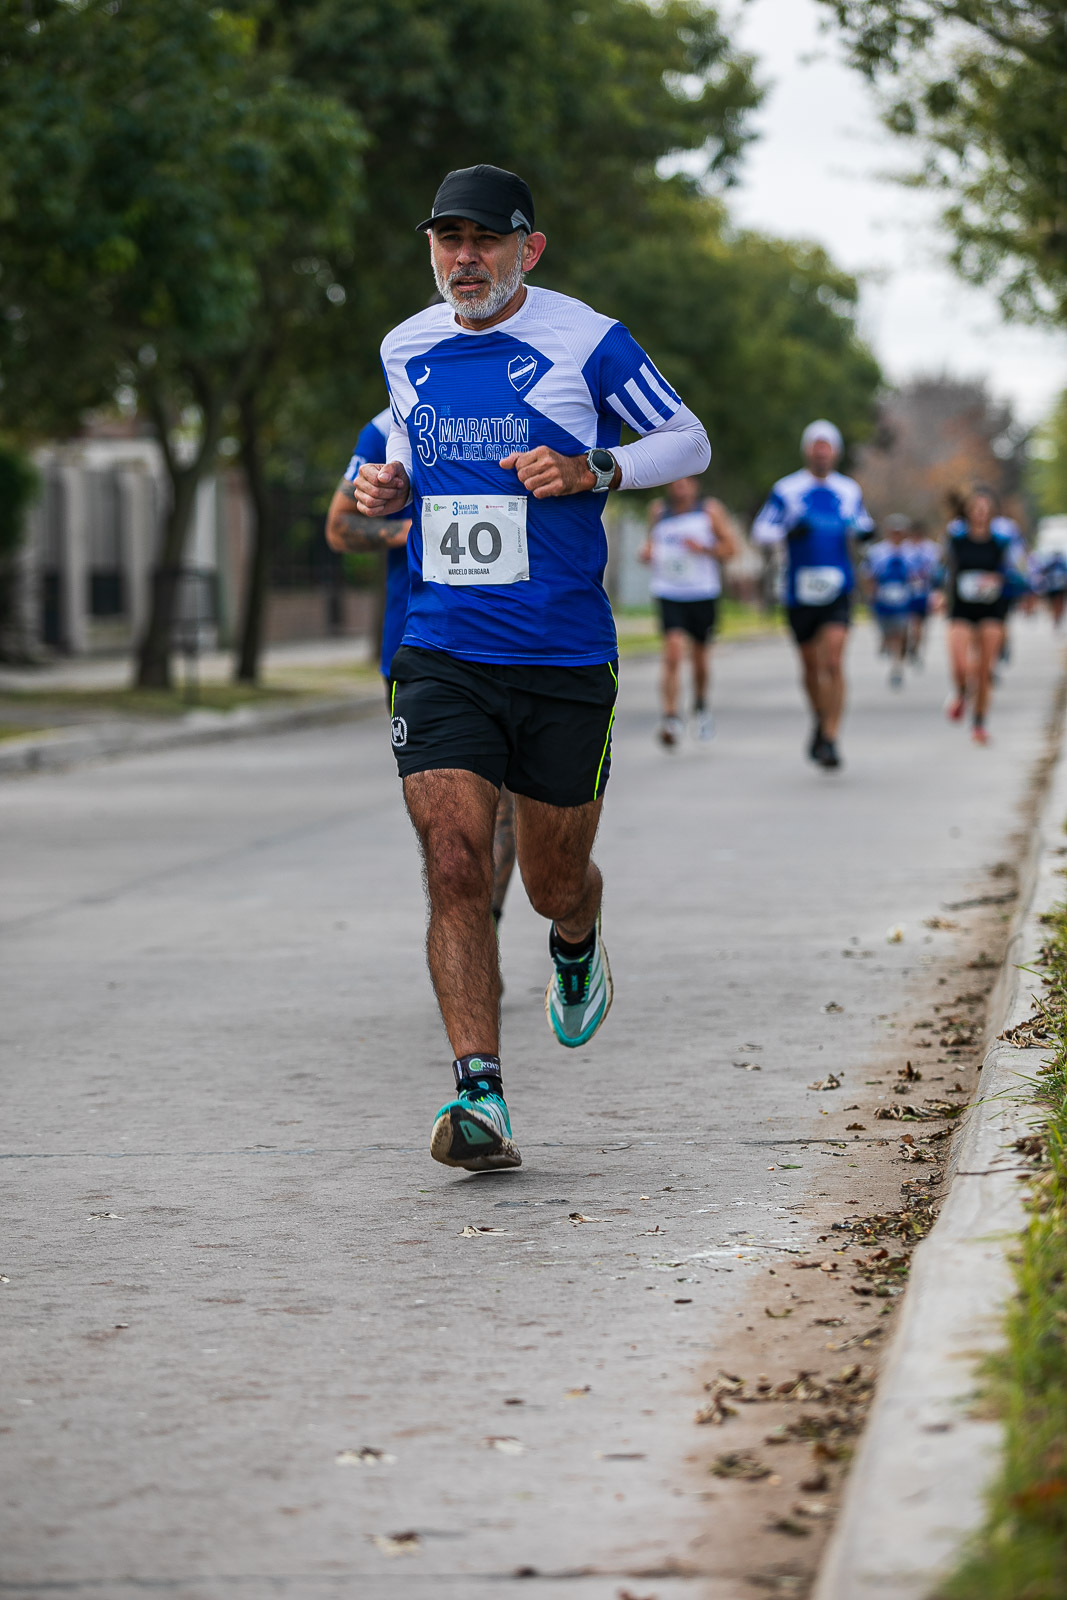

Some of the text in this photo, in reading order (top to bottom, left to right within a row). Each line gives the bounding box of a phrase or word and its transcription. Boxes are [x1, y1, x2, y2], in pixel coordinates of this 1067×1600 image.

[414, 404, 529, 466] 3 MARATÓN
[452, 501, 459, 516] 3
[440, 521, 502, 564] 40
[468, 567, 490, 575] BERGARA
